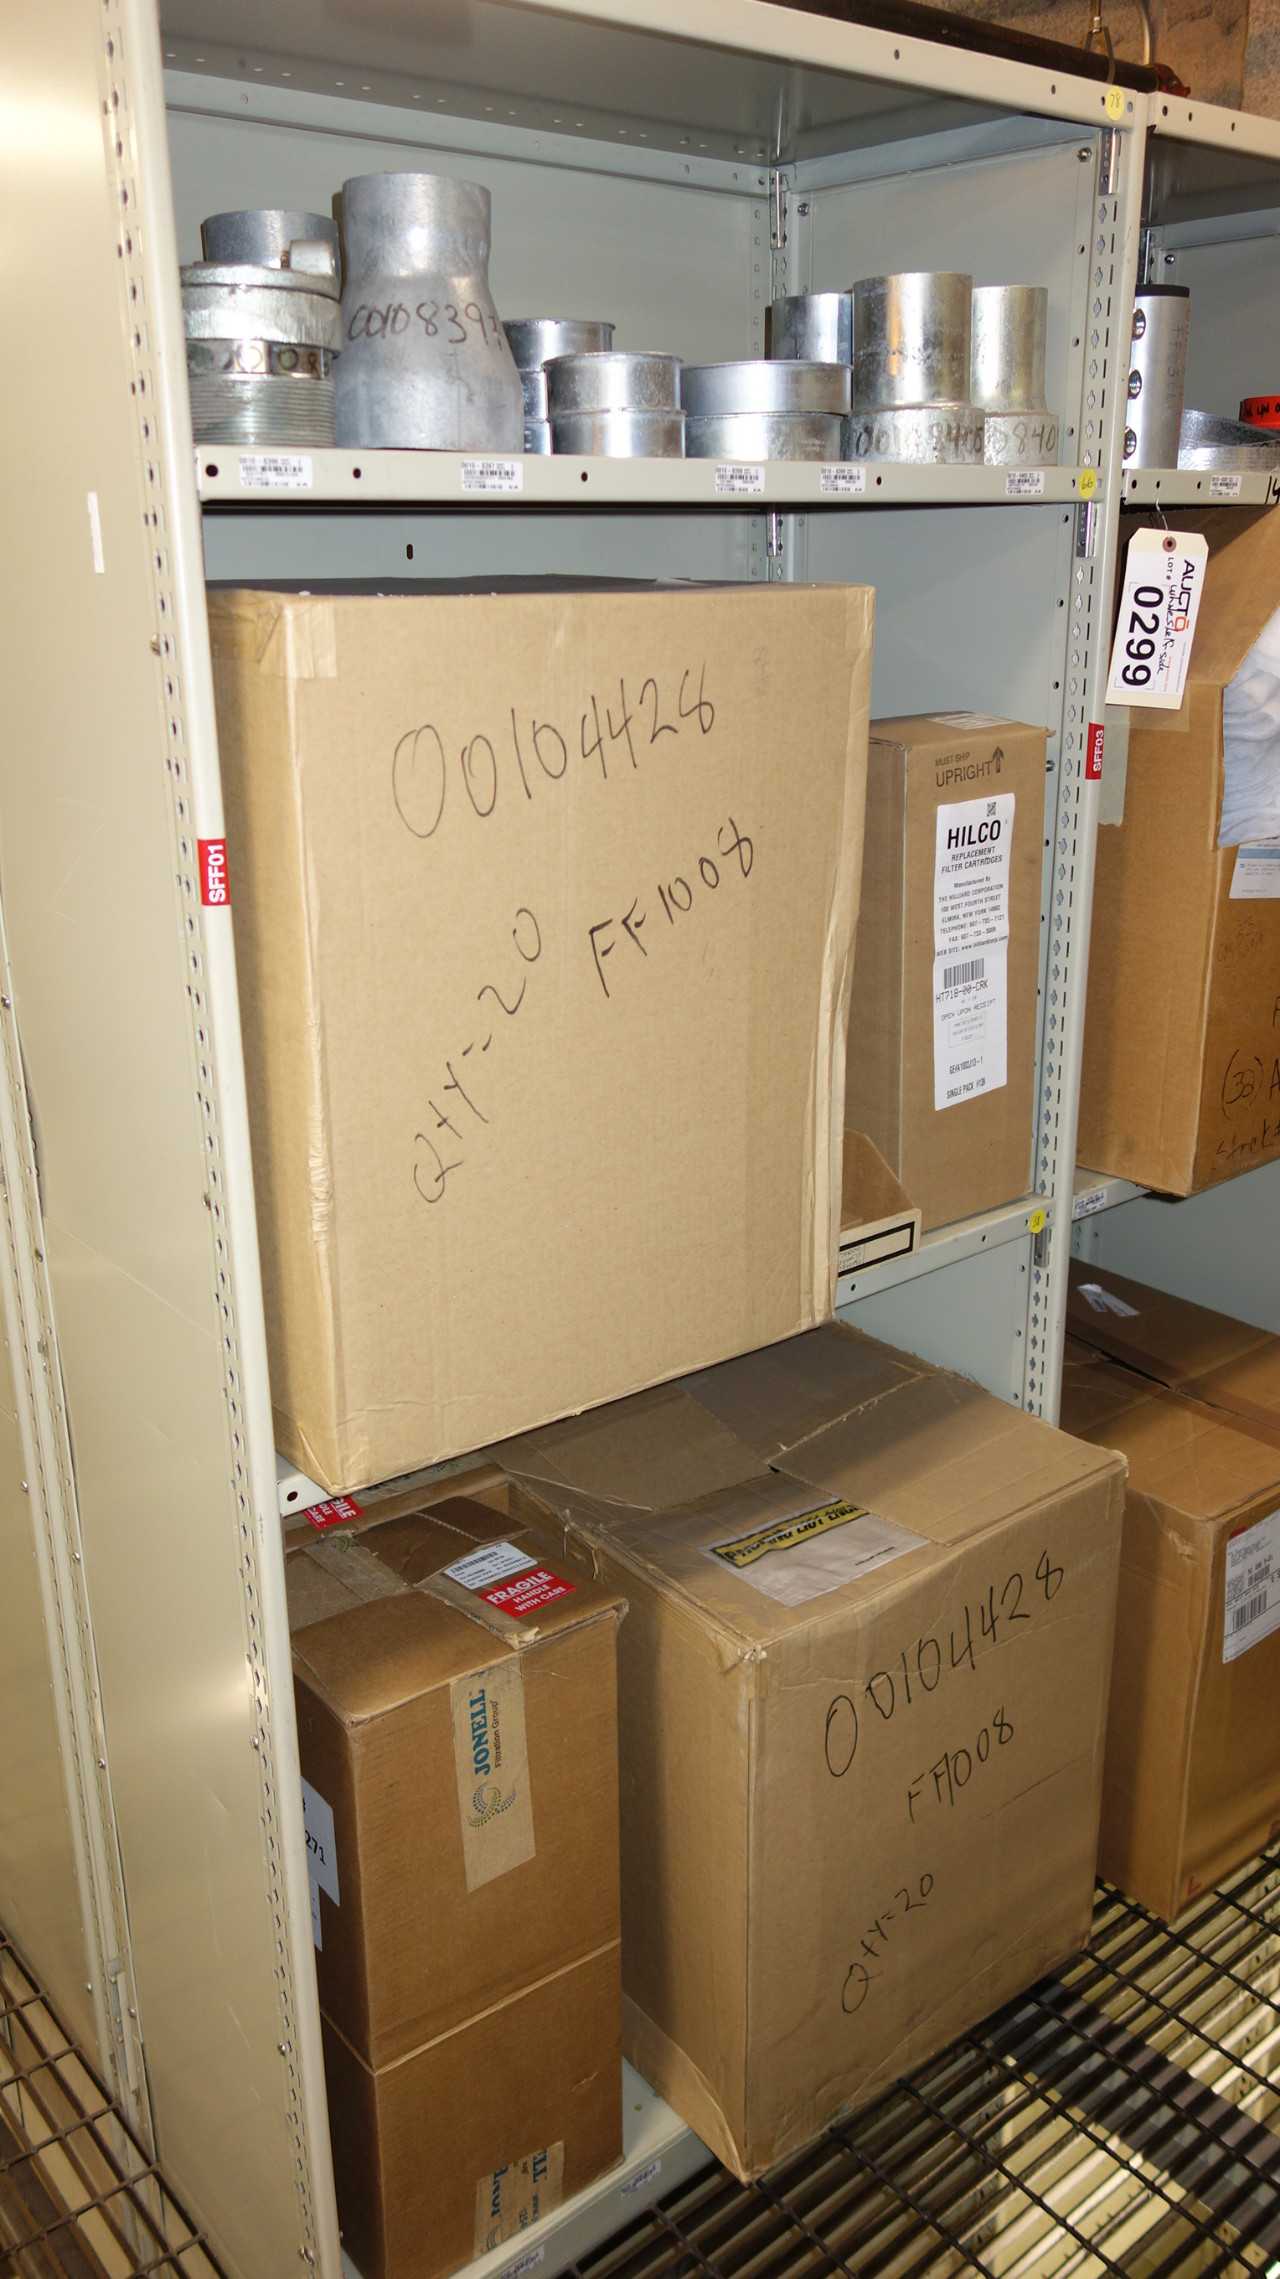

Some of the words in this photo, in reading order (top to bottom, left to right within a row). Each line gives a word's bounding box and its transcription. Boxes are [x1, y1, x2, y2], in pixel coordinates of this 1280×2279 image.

[1121, 585, 1164, 687] 0299
[391, 662, 716, 839] 00104428
[1093, 729, 1105, 772] SFF03
[935, 760, 994, 788] UPRIGHT
[946, 818, 1002, 851] HILCO
[950, 845, 996, 862] REPLACEMENT
[207, 844, 226, 904] SFF01
[941, 862, 963, 874] FILTER
[964, 854, 1003, 870] CARTRIDGES
[588, 817, 754, 999] FF1008
[486, 1571, 555, 1605] FRAGILE
[512, 1584, 551, 1603] HANDLE
[515, 1597, 541, 1612] WITH
[540, 1585, 567, 1600] CARE
[824, 1549, 1064, 1778] 00104428
[469, 1689, 491, 1776] JONELL
